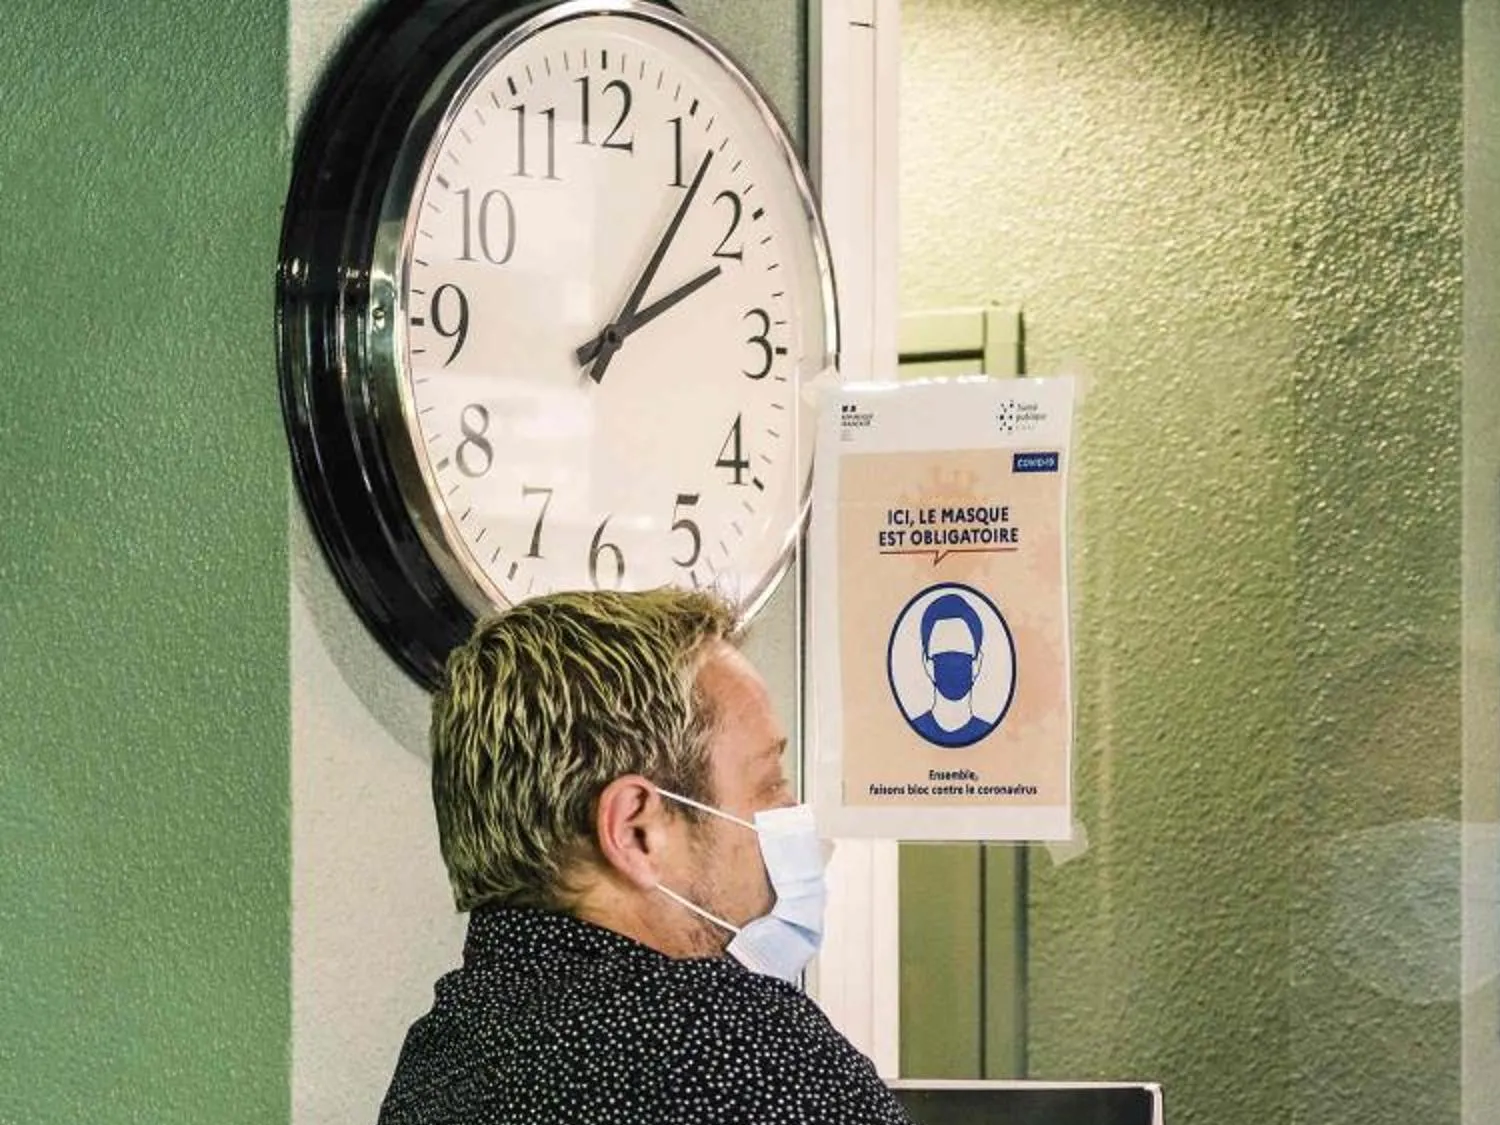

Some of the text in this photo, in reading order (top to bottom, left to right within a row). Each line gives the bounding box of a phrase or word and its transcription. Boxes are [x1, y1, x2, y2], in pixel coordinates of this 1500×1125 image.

[510, 103, 563, 181] 11
[572, 75, 634, 153] 12
[667, 116, 689, 189] 1
[455, 187, 517, 266] 10
[712, 190, 744, 261] 2
[431, 283, 470, 367] 9
[742, 308, 774, 380] 3
[455, 403, 494, 478] 8
[714, 411, 750, 486] 4
[521, 487, 553, 559] 7
[588, 513, 625, 591] 6
[671, 493, 700, 568] 5
[879, 527, 1019, 547] EST OBLIGATOIRE
[888, 506, 1009, 527] ICI, LE MASQUE
[869, 783, 1037, 795] faisons bloc contre le coronavirus
[928, 769, 979, 782] Ensemble,
